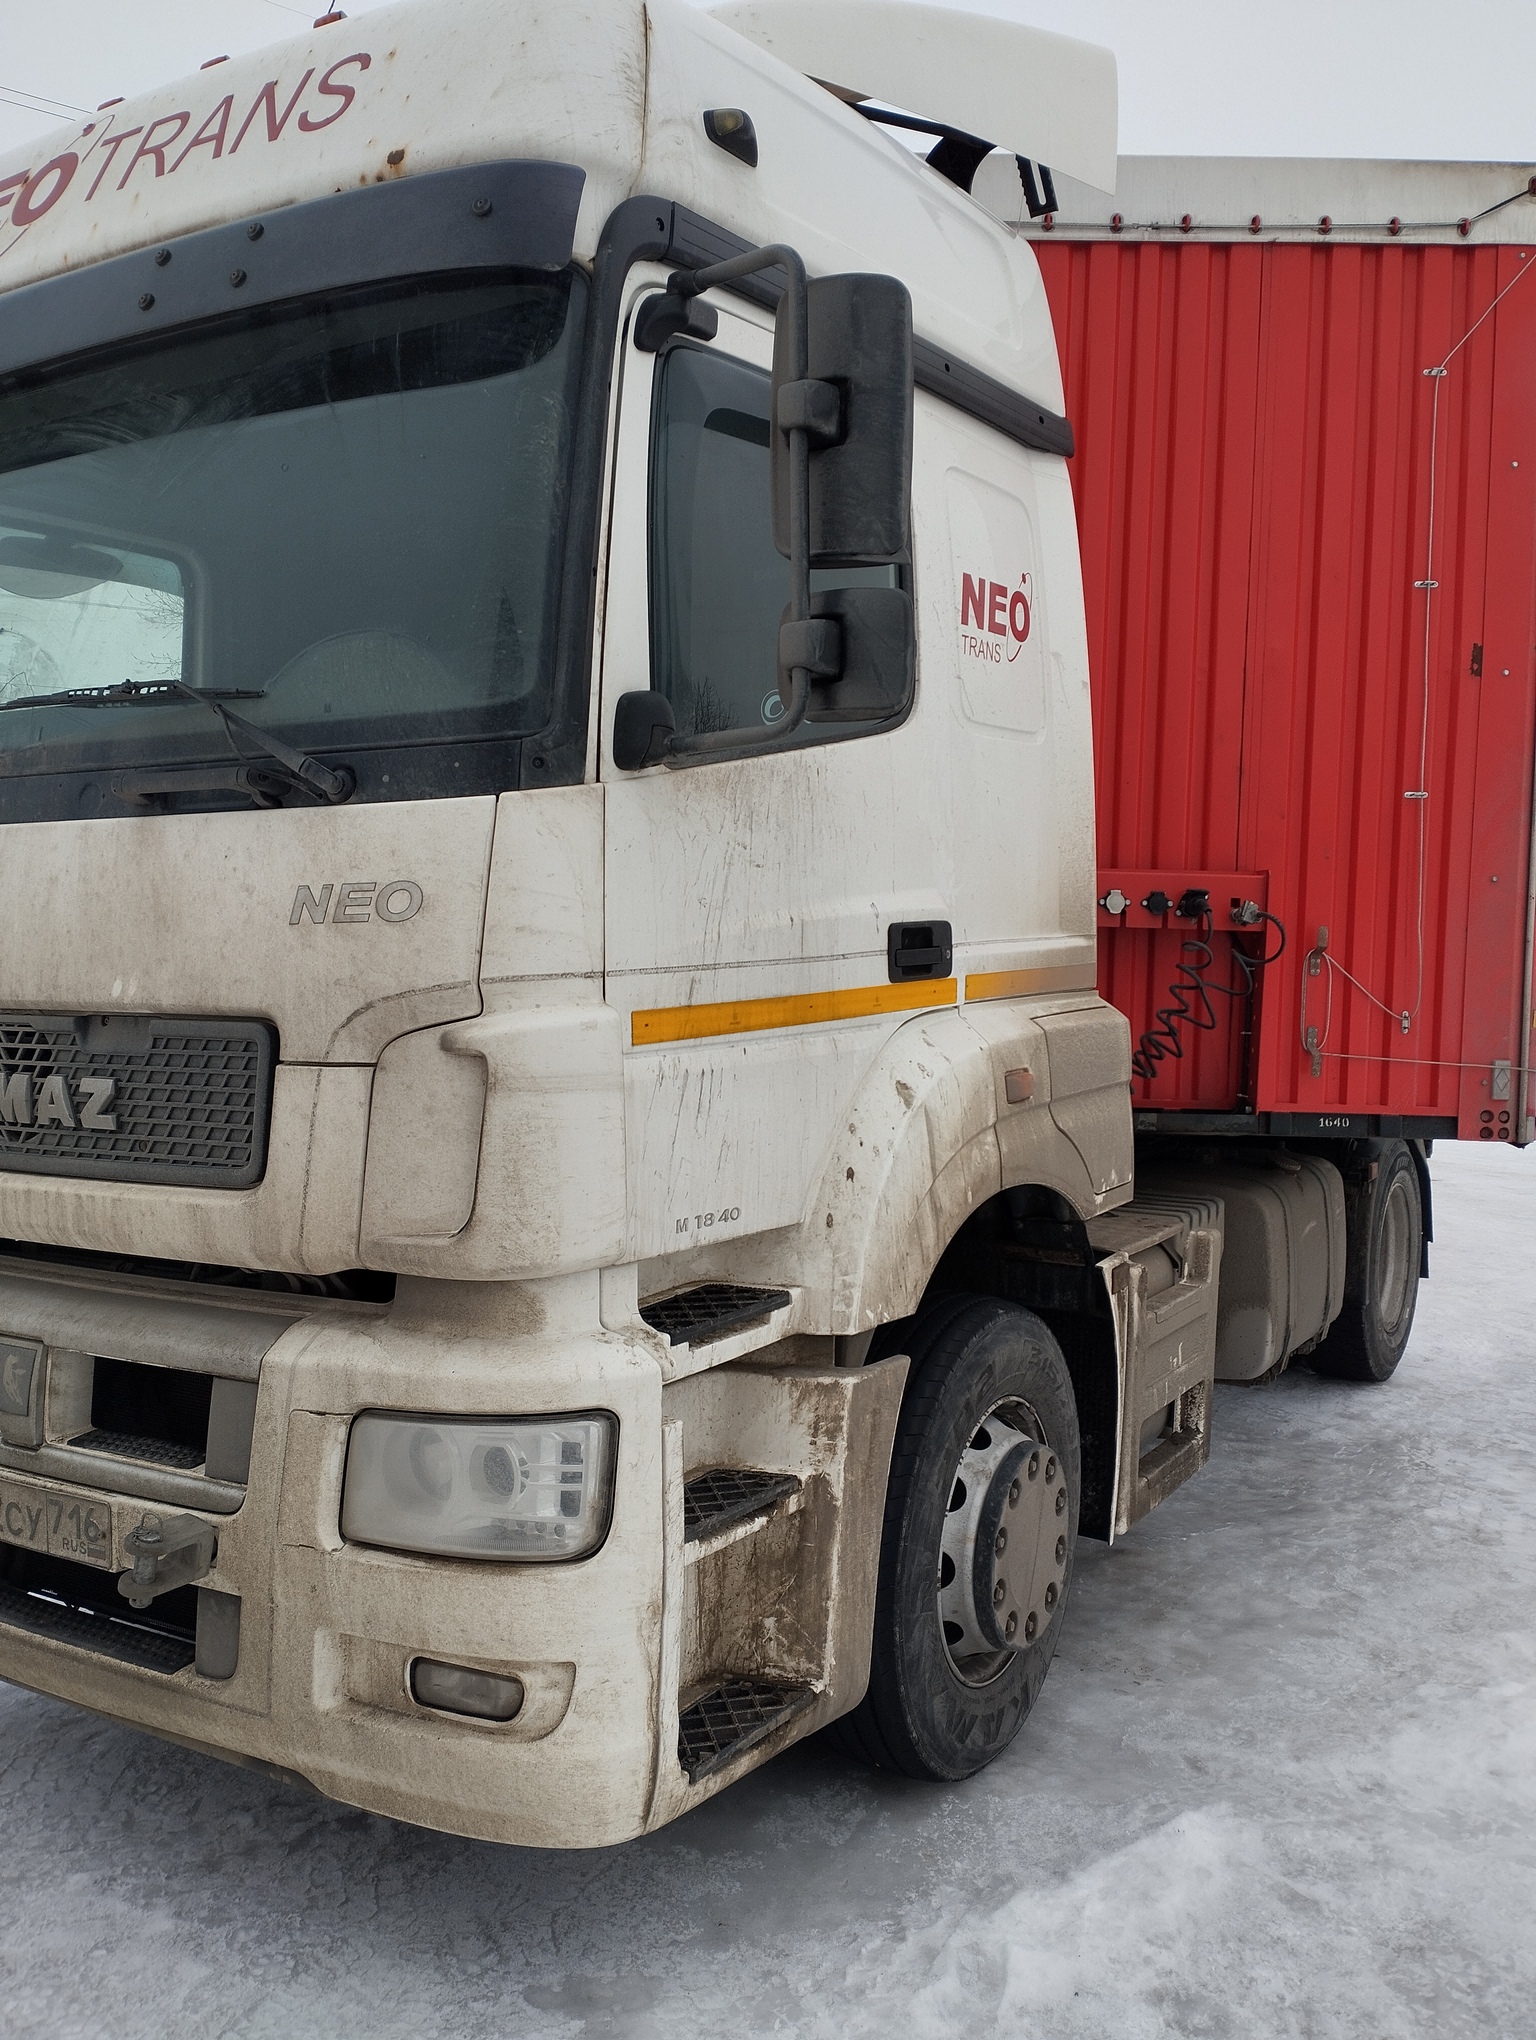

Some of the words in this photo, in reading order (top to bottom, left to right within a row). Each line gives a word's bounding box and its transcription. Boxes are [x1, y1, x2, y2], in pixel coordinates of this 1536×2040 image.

[84, 52, 372, 202] TRANS
[961, 572, 1030, 643] NEO
[961, 634, 1002, 663] TRANS
[289, 880, 423, 925] NEO
[1319, 1117, 1350, 1128] 1640
[0, 1500, 43, 1541] CY
[48, 1498, 101, 1543] 716
[62, 1537, 87, 1555] RUS
